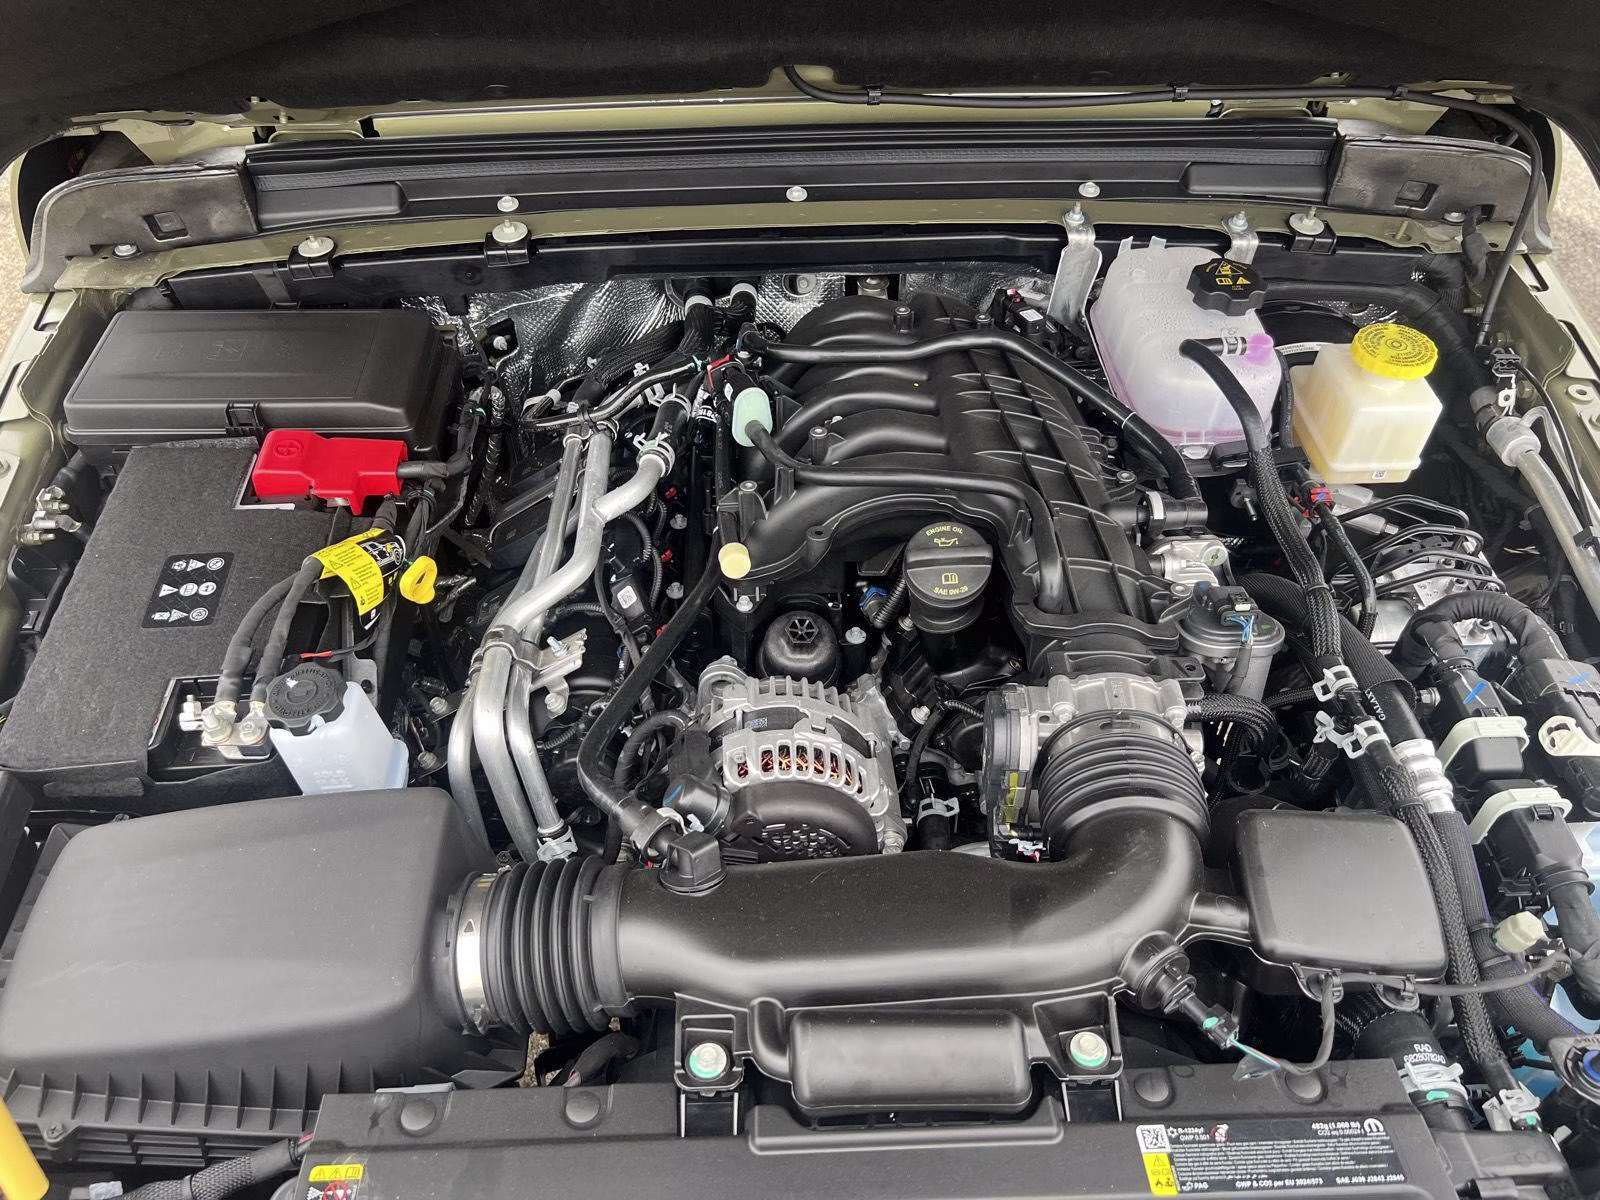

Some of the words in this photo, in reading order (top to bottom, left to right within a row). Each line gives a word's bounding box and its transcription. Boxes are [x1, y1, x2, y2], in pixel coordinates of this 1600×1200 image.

[925, 525, 951, 537] ENGINE
[952, 526, 963, 534] OIL
[933, 587, 948, 595] SAE
[948, 585, 969, 595] 0W-20
[1413, 1043, 1433, 1053] RAD
[1235, 1180, 1252, 1188] GWP
[1258, 1179, 1273, 1187] CO2
[1273, 1179, 1284, 1188] per
[1284, 1178, 1295, 1186] EU
[1335, 1176, 1351, 1184] SAE
